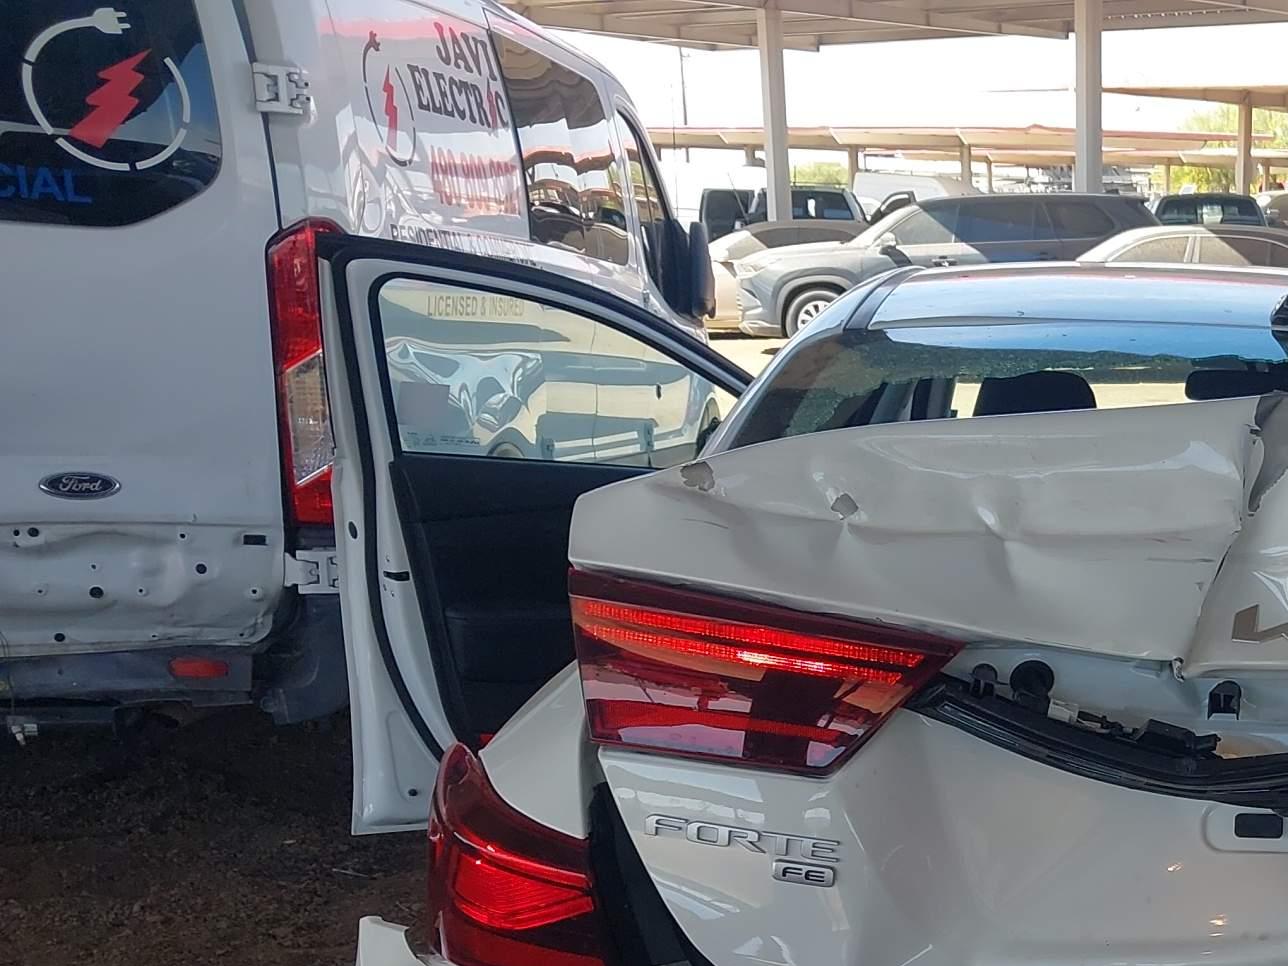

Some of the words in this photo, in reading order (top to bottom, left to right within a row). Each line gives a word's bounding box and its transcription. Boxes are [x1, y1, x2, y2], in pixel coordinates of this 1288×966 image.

[433, 21, 498, 82] JAVI
[406, 63, 510, 131] ELECTRIC
[427, 294, 478, 317] LICENSED
[479, 296, 487, 317] &
[489, 297, 525, 318] INSURED
[58, 474, 103, 492] Ford
[644, 812, 841, 864] FORTE
[780, 864, 828, 884] FE
